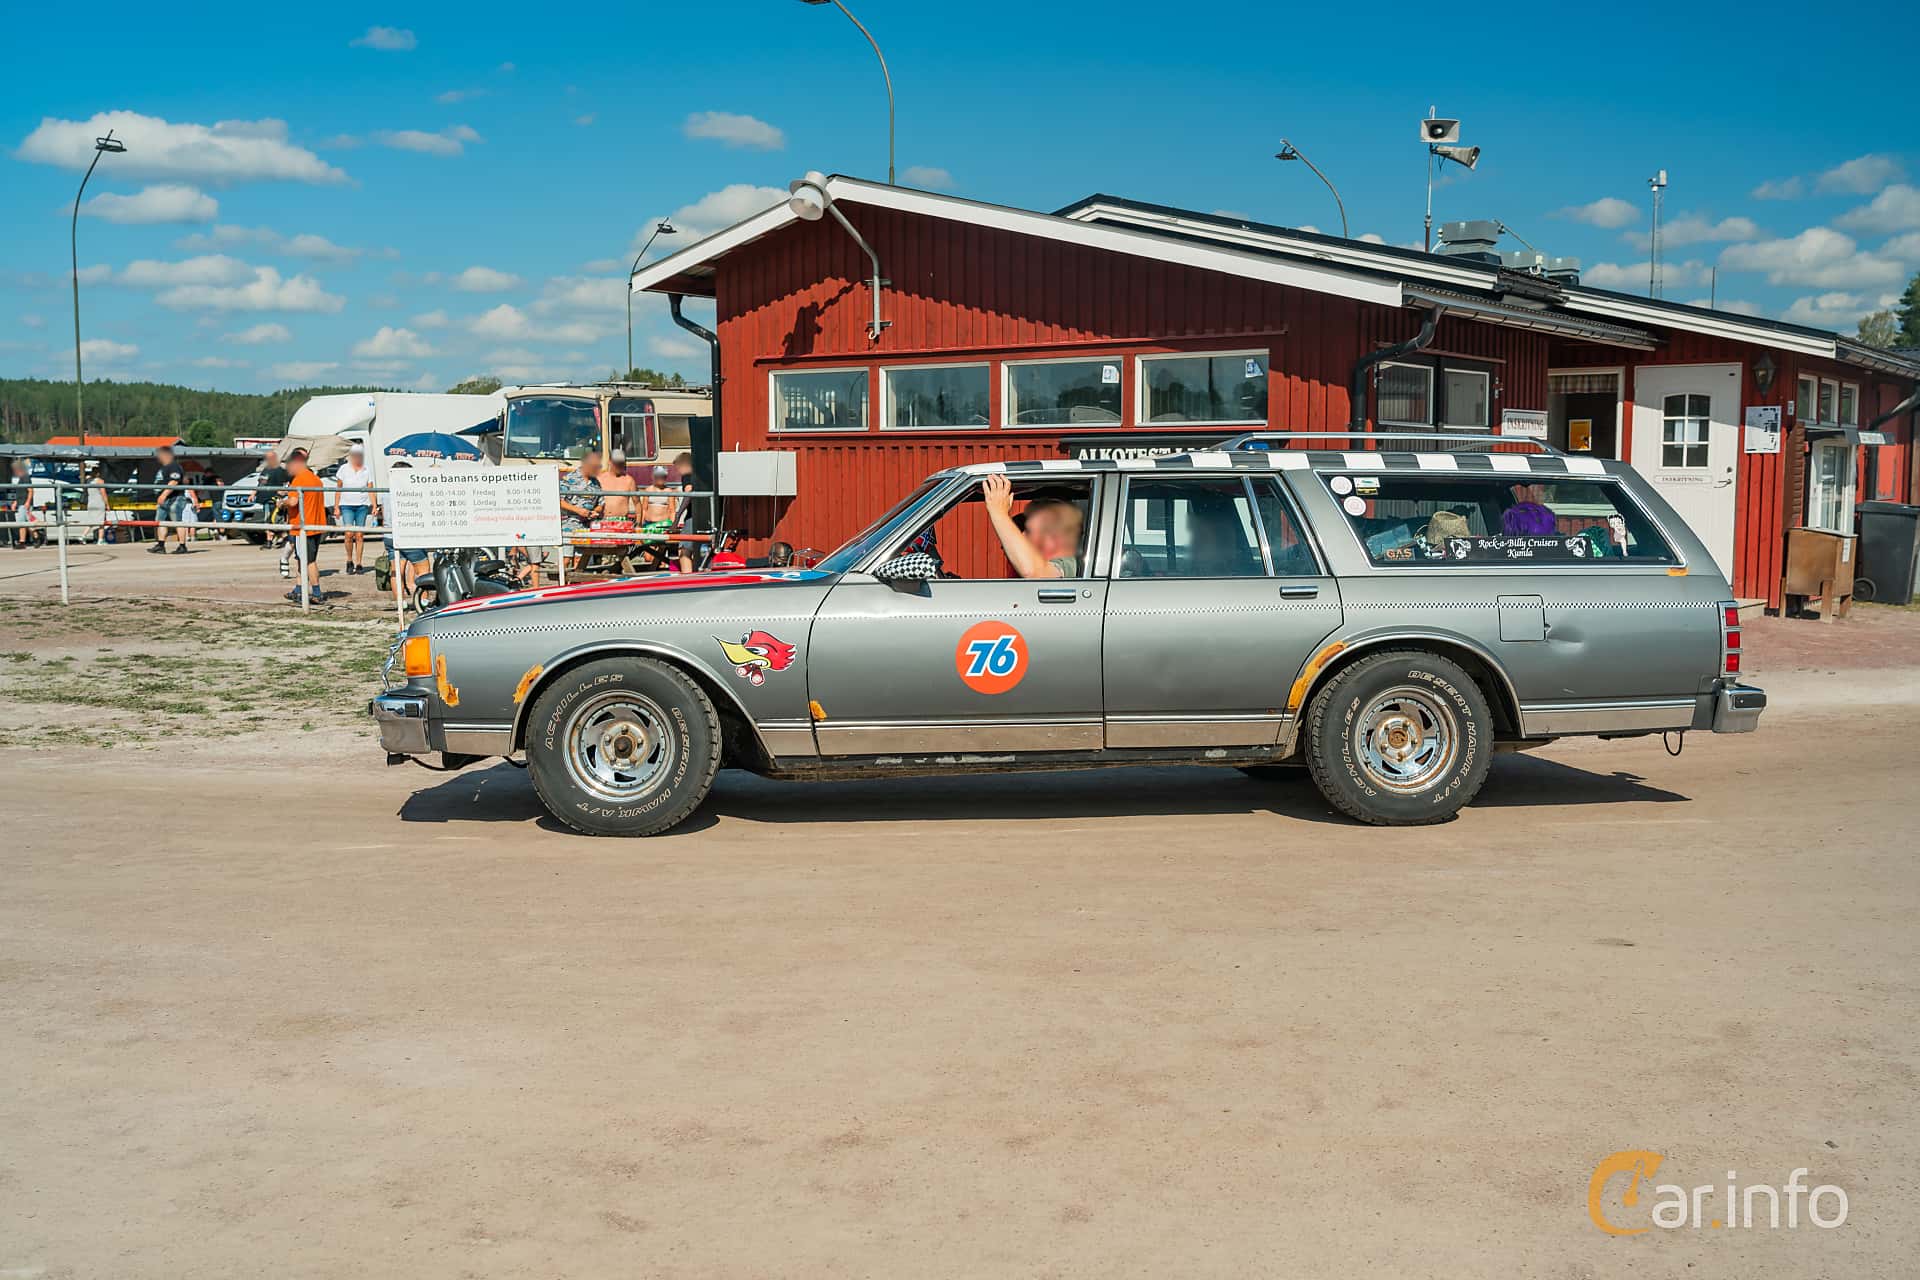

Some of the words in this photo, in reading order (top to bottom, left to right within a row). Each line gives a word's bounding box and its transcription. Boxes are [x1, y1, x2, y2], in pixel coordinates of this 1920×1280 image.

[409, 474, 438, 484] Stora
[440, 473, 479, 483] banans
[1386, 548, 1412, 558] GAS
[1527, 538, 1558, 548] Cruisers
[965, 634, 1017, 677] 76
[1408, 670, 1472, 717] DESERT
[545, 673, 624, 750] ACHILLES
